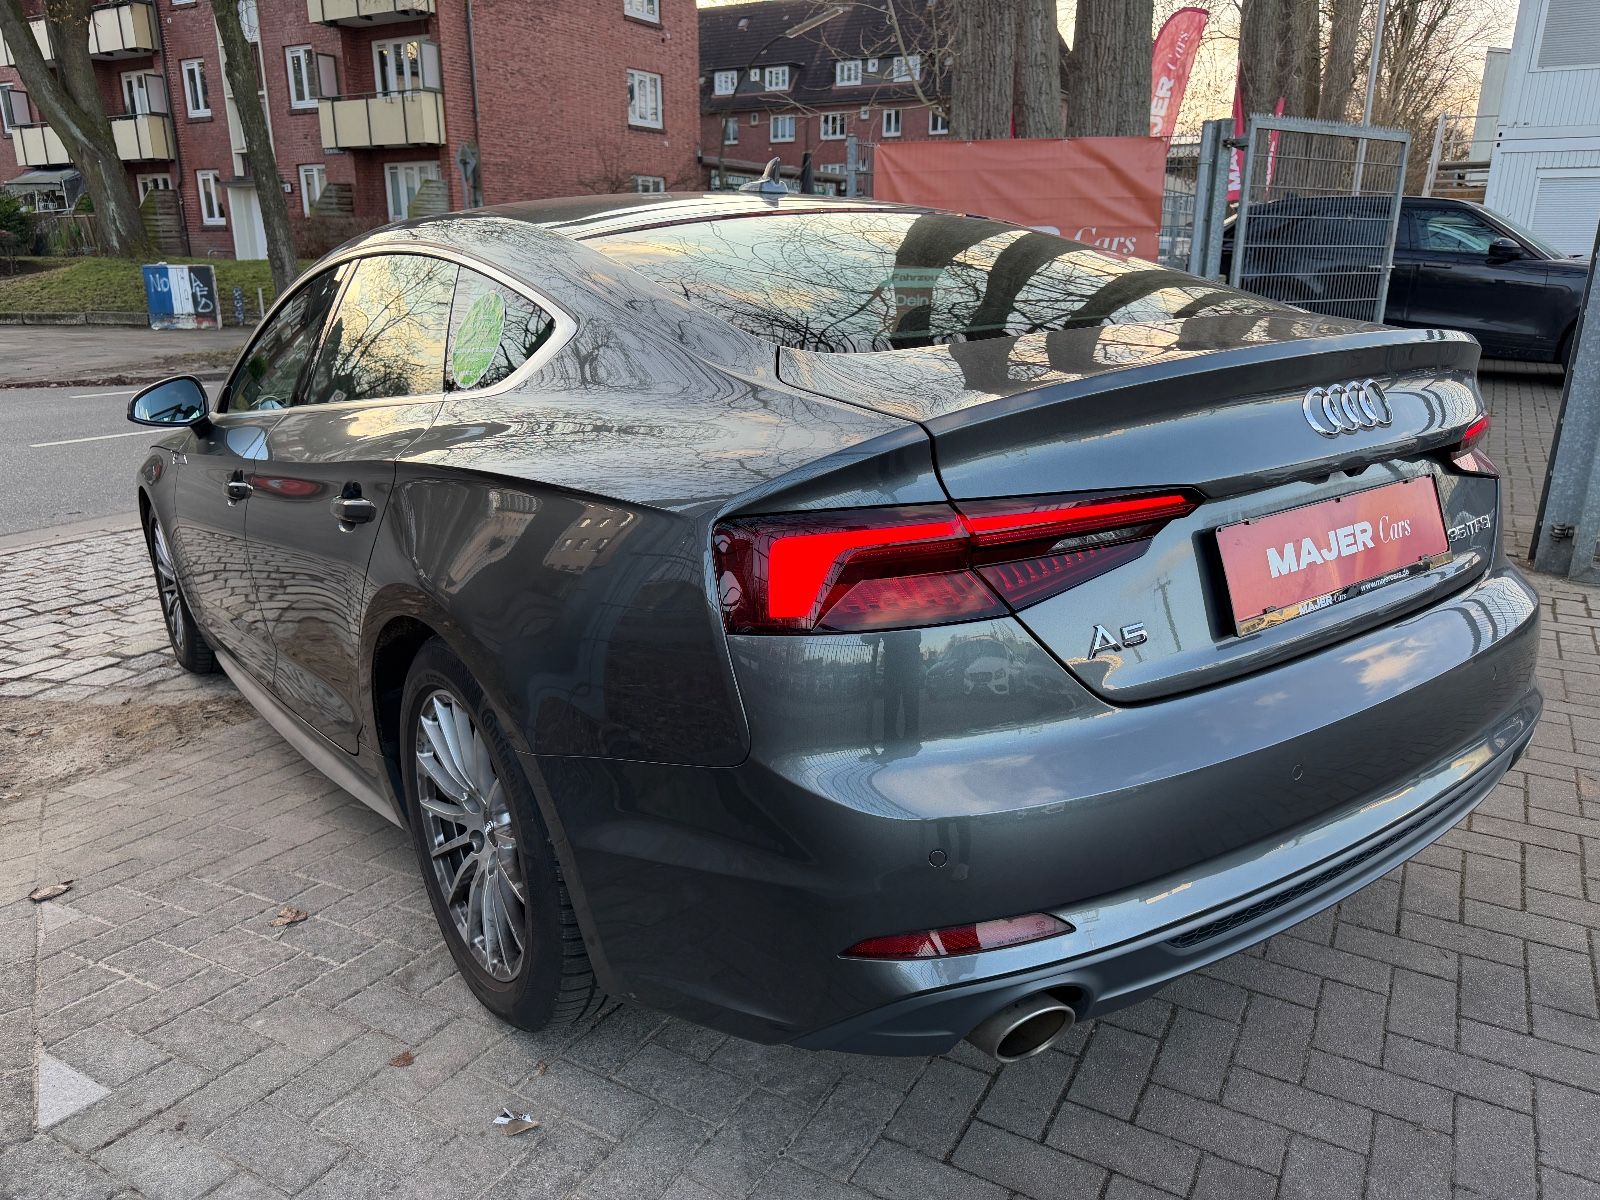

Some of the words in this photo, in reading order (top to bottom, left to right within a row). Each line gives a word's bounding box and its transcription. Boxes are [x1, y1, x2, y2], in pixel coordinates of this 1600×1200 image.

[1150, 76, 1174, 135] JER
[892, 273, 939, 282] Fahrzeu
[896, 294, 929, 306] Dein
[1266, 520, 1375, 578] MAJER
[1379, 515, 1411, 543] Cars
[1299, 594, 1334, 615] MAJER
[1087, 621, 1148, 661] A5
